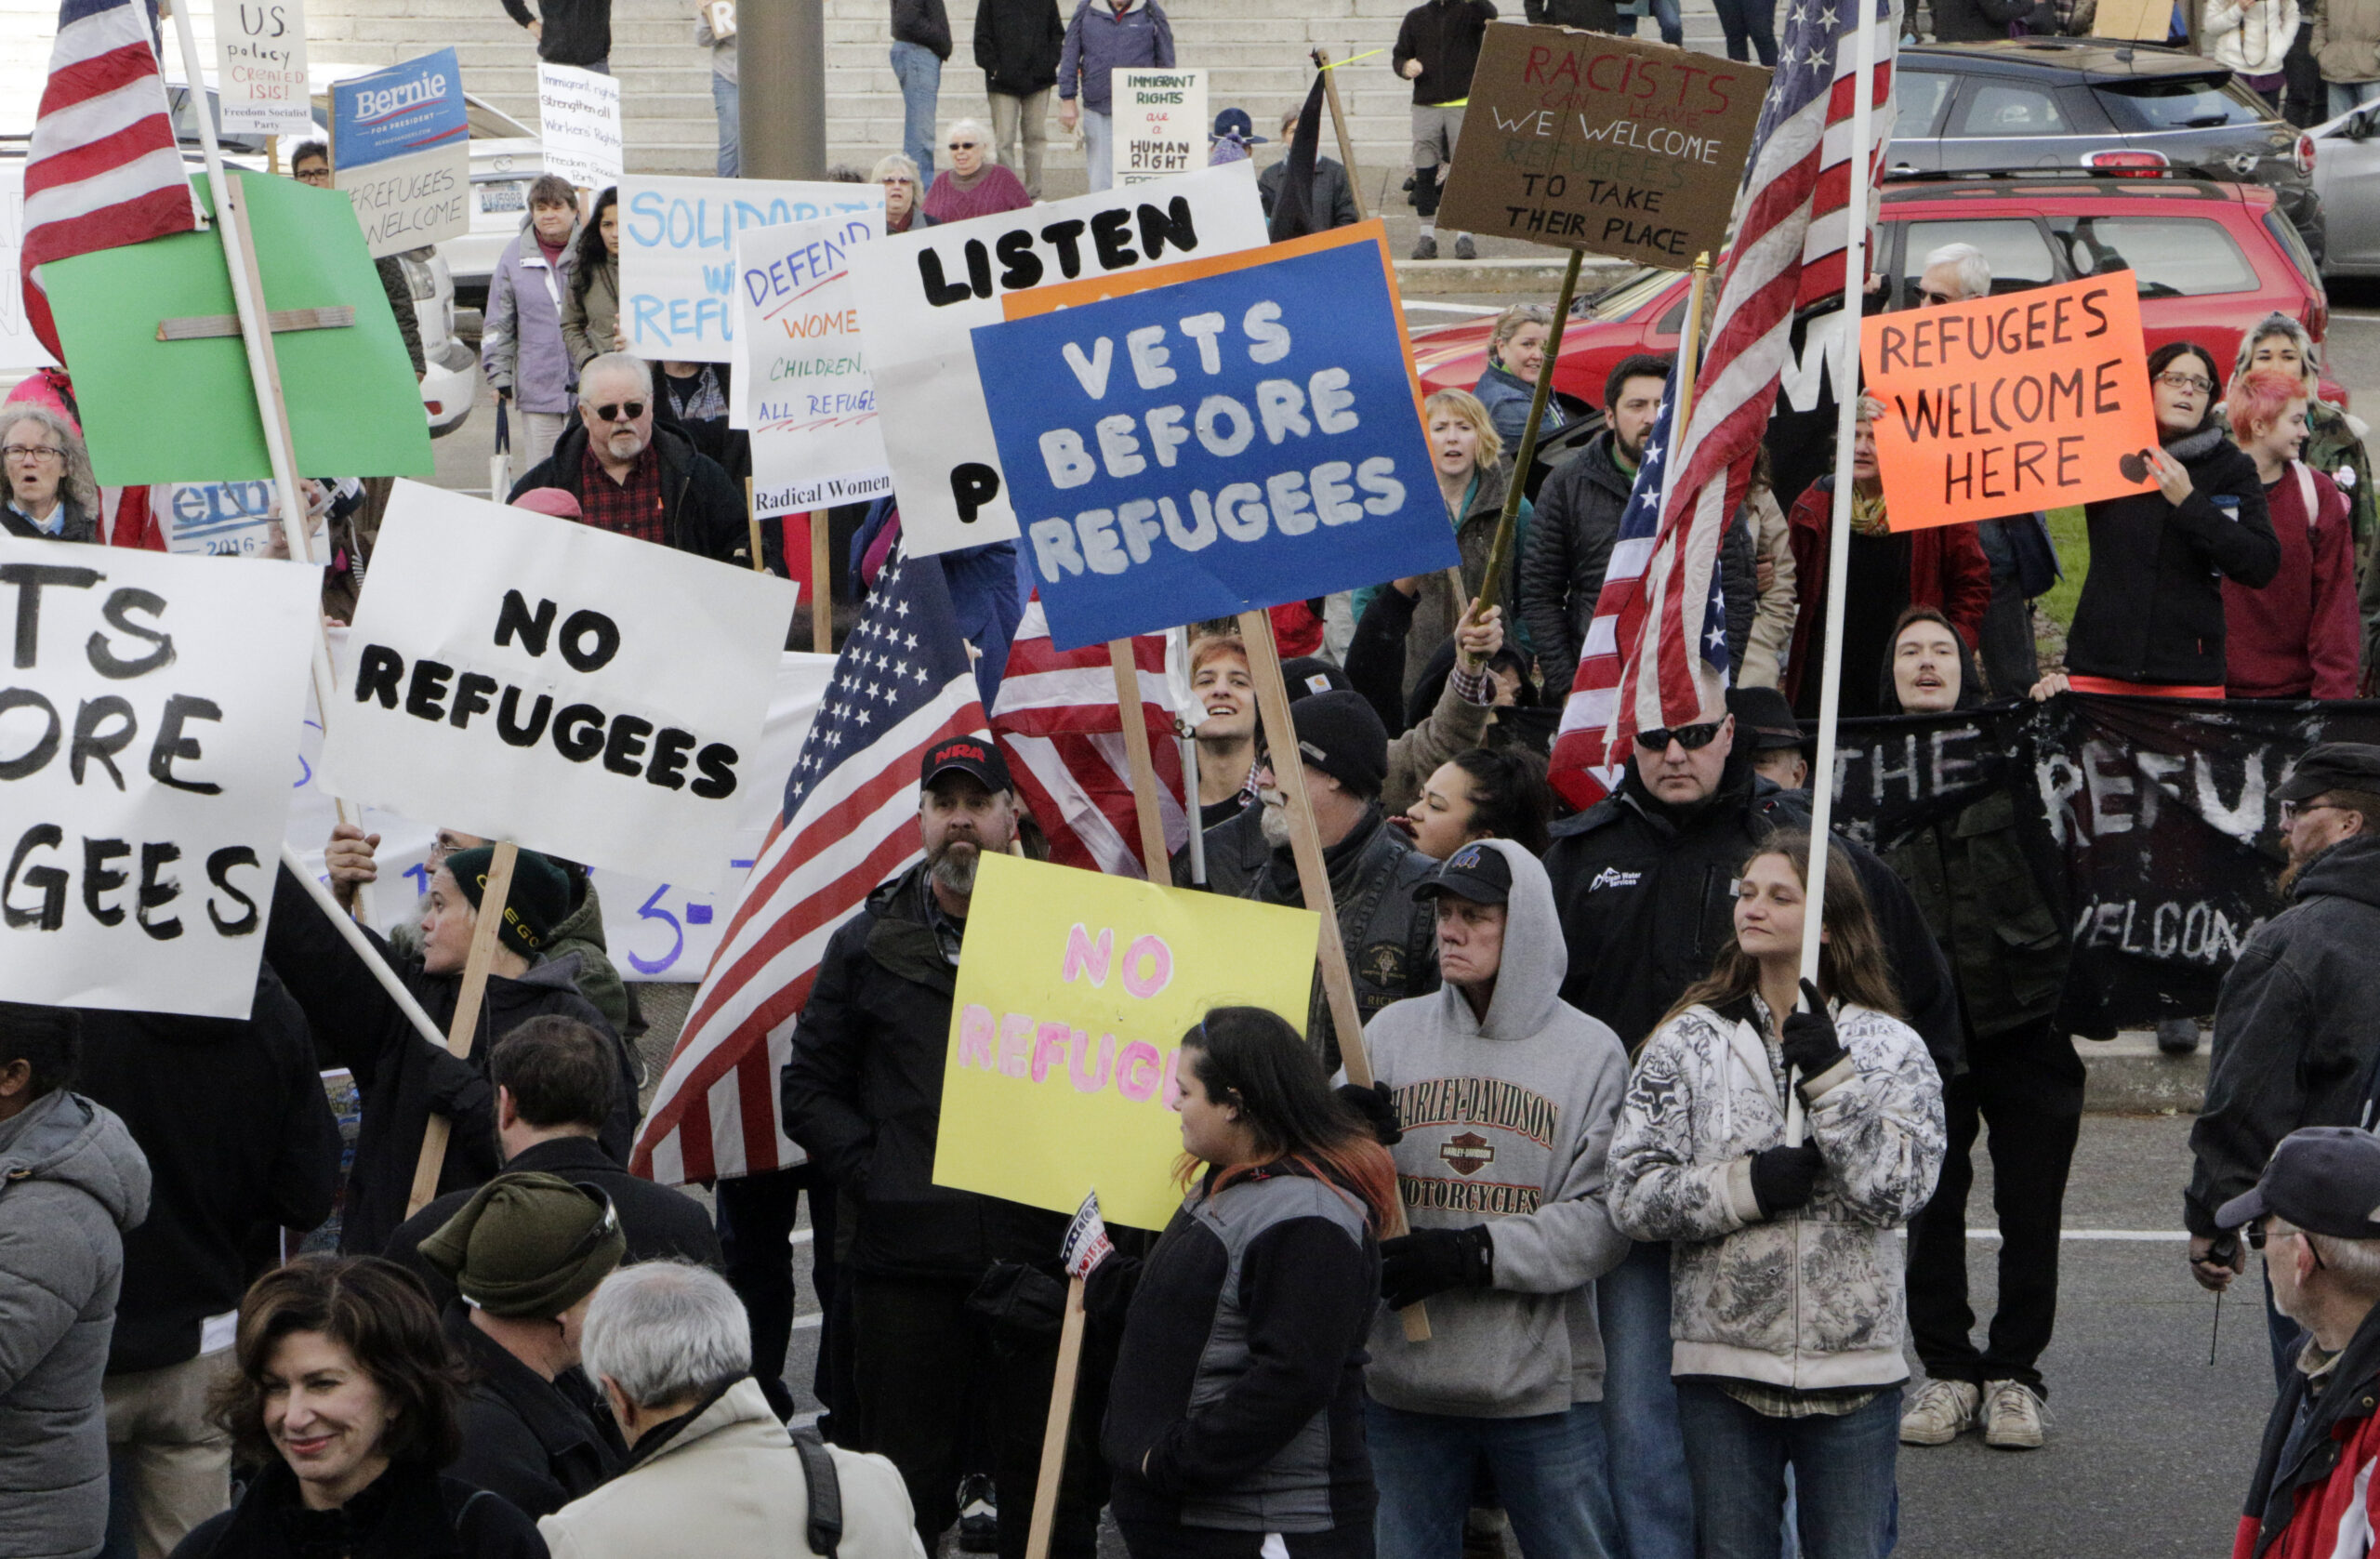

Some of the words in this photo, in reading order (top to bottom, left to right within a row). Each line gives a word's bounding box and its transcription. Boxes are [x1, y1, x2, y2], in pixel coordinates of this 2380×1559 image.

[240, 4, 290, 37] U.S.
[227, 42, 290, 70] policy
[249, 84, 288, 99] ISIS!
[355, 71, 446, 119] Bernie
[1128, 74, 1196, 87] IMMIGRANT
[1136, 91, 1183, 104] RIGHTS
[1524, 46, 1736, 114] RACISTS
[224, 108, 266, 116] Freedom
[269, 109, 307, 117] Socialist
[254, 120, 280, 129] Party
[371, 123, 388, 134] FOR
[390, 112, 435, 129] PRESIDENT
[597, 106, 611, 119] all
[1146, 112, 1169, 122] are
[1540, 90, 1589, 111] CAN
[1628, 103, 1702, 128] LEAVE
[1130, 139, 1190, 153] HUMAN
[1492, 106, 1555, 136] WE
[1580, 113, 1722, 164] WELCOME
[545, 152, 588, 167] Freedom
[571, 169, 598, 186] Party
[1131, 153, 1187, 169] RIGHT
[1501, 139, 1687, 190] REFUGEES
[1523, 173, 1566, 197] TO
[1589, 179, 1663, 213] TAKE
[1505, 206, 1586, 236] THEIR
[1603, 218, 1689, 256] PLACE
[918, 196, 1197, 307] LISTEN
[782, 310, 860, 338] WOME
[1880, 289, 2109, 374] REFUGEES
[1062, 300, 1291, 400] VETS
[759, 402, 794, 420] ALL
[1895, 358, 2122, 443] WELCOME
[1038, 367, 1358, 489] BEFORE
[1945, 435, 2084, 504] HERE
[756, 483, 822, 511] Radical
[827, 475, 890, 497] Women
[1029, 456, 1406, 583] REFUGEES
[206, 537, 255, 556] 2016
[0, 563, 178, 680] TS
[494, 588, 620, 673] NO
[0, 687, 223, 795] ORE
[355, 643, 739, 799] REFUGEES
[935, 744, 985, 765] NRA
[1832, 725, 1987, 803] THE
[2035, 741, 2297, 847] REFU
[1, 823, 261, 941] GEES
[1062, 922, 1174, 999] NO
[1393, 1077, 1559, 1151] HARLEY-DAVIDSON
[1442, 1146, 1492, 1159] HARLEY-DAVIDSON
